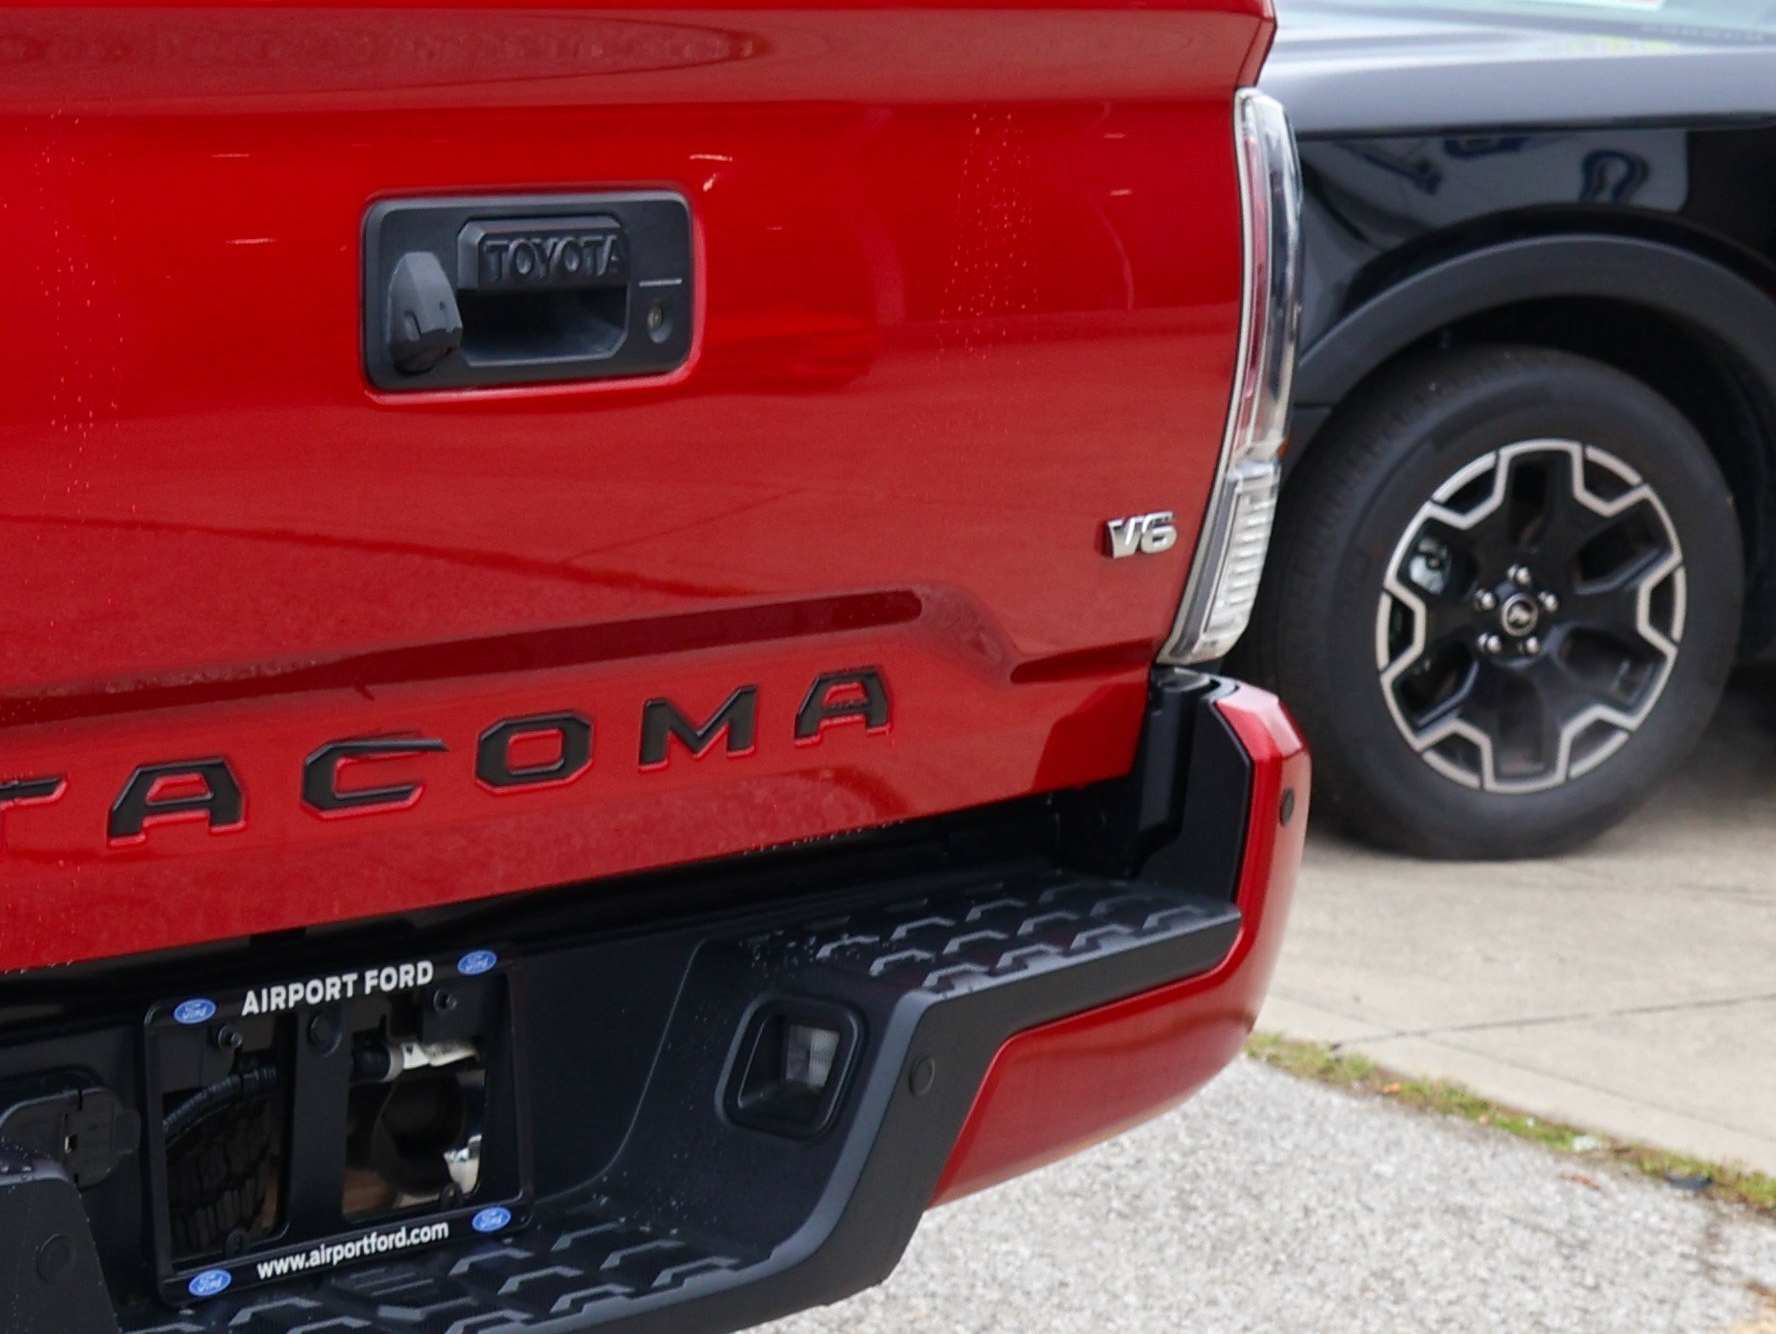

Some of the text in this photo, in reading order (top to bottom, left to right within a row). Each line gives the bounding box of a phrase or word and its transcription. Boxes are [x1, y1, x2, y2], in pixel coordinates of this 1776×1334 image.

[483, 234, 628, 283] TOYOTA
[1107, 511, 1178, 559] V6
[241, 960, 434, 1016] AIRPORT FORD
[256, 1221, 449, 1280] www.airportford.com
